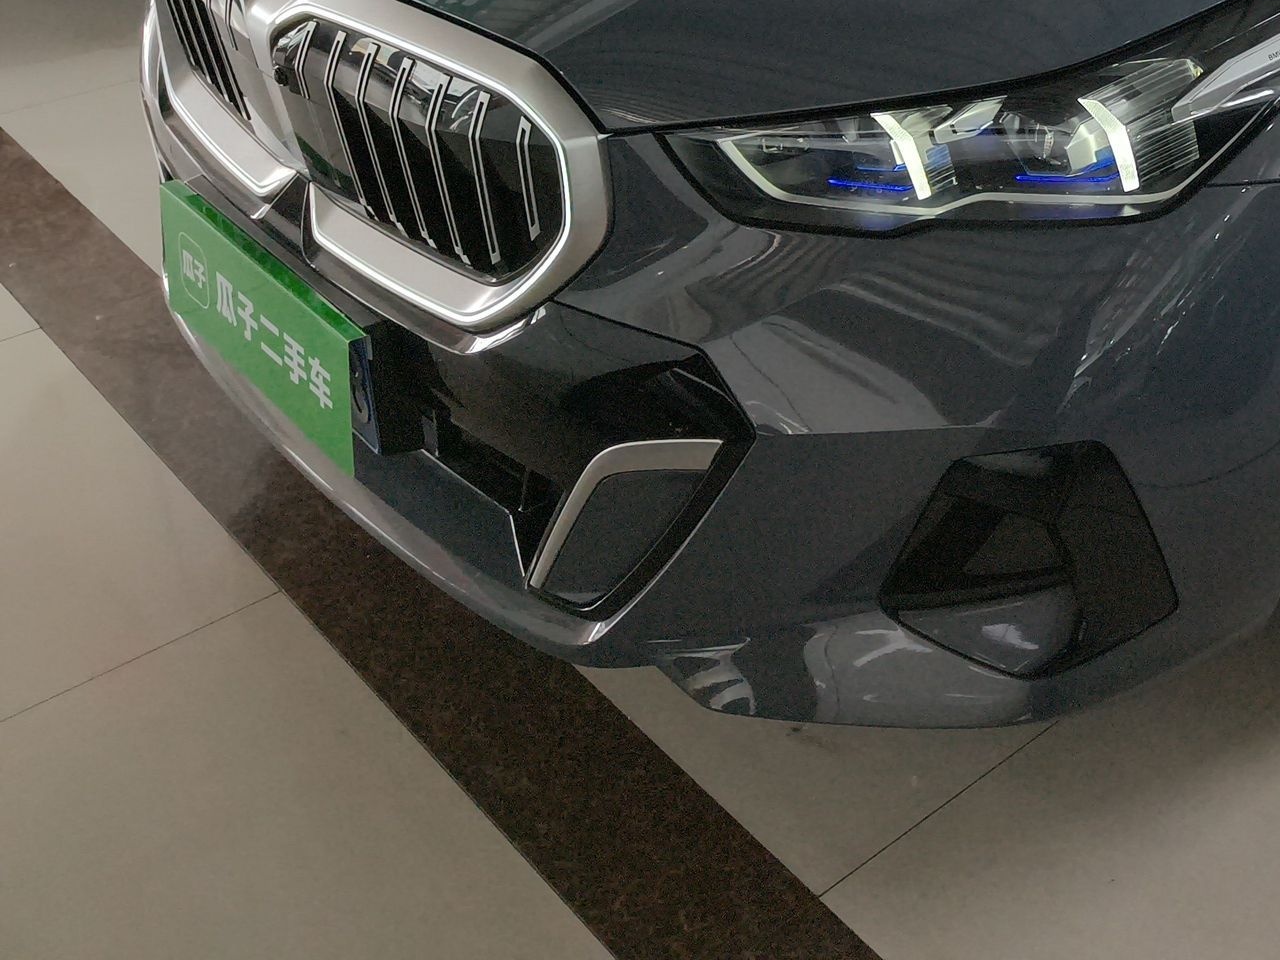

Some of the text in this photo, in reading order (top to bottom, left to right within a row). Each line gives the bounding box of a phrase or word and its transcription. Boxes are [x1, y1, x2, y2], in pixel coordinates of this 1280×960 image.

[181, 248, 207, 290] 瓜子
[215, 270, 334, 410] 瓜子二手车
